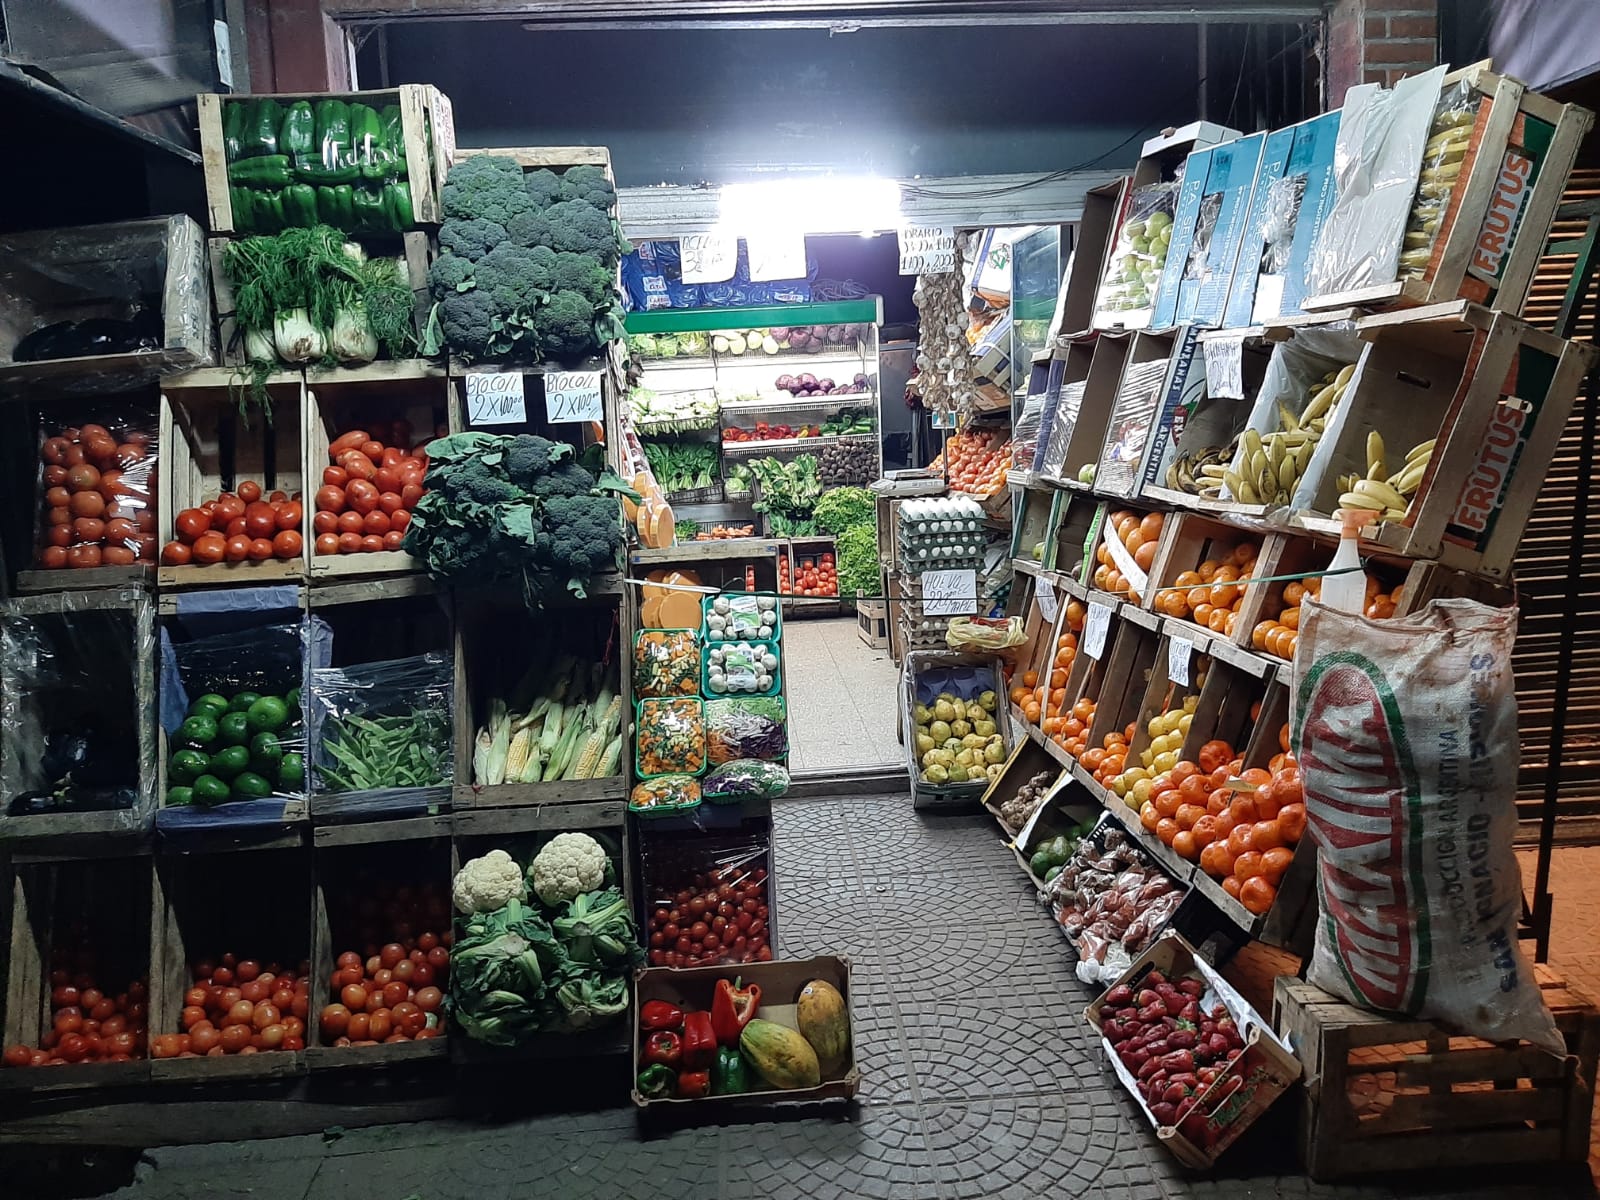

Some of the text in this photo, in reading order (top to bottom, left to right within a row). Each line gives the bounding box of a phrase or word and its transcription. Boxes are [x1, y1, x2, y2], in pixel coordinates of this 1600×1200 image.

[1241, 202, 1268, 292] SEEZIONI
[1474, 154, 1529, 272] FRUTUS
[1172, 326, 1200, 391] MANZANAS
[1145, 424, 1169, 482] ARGENTIN
[1458, 404, 1526, 530] FRUTUS
